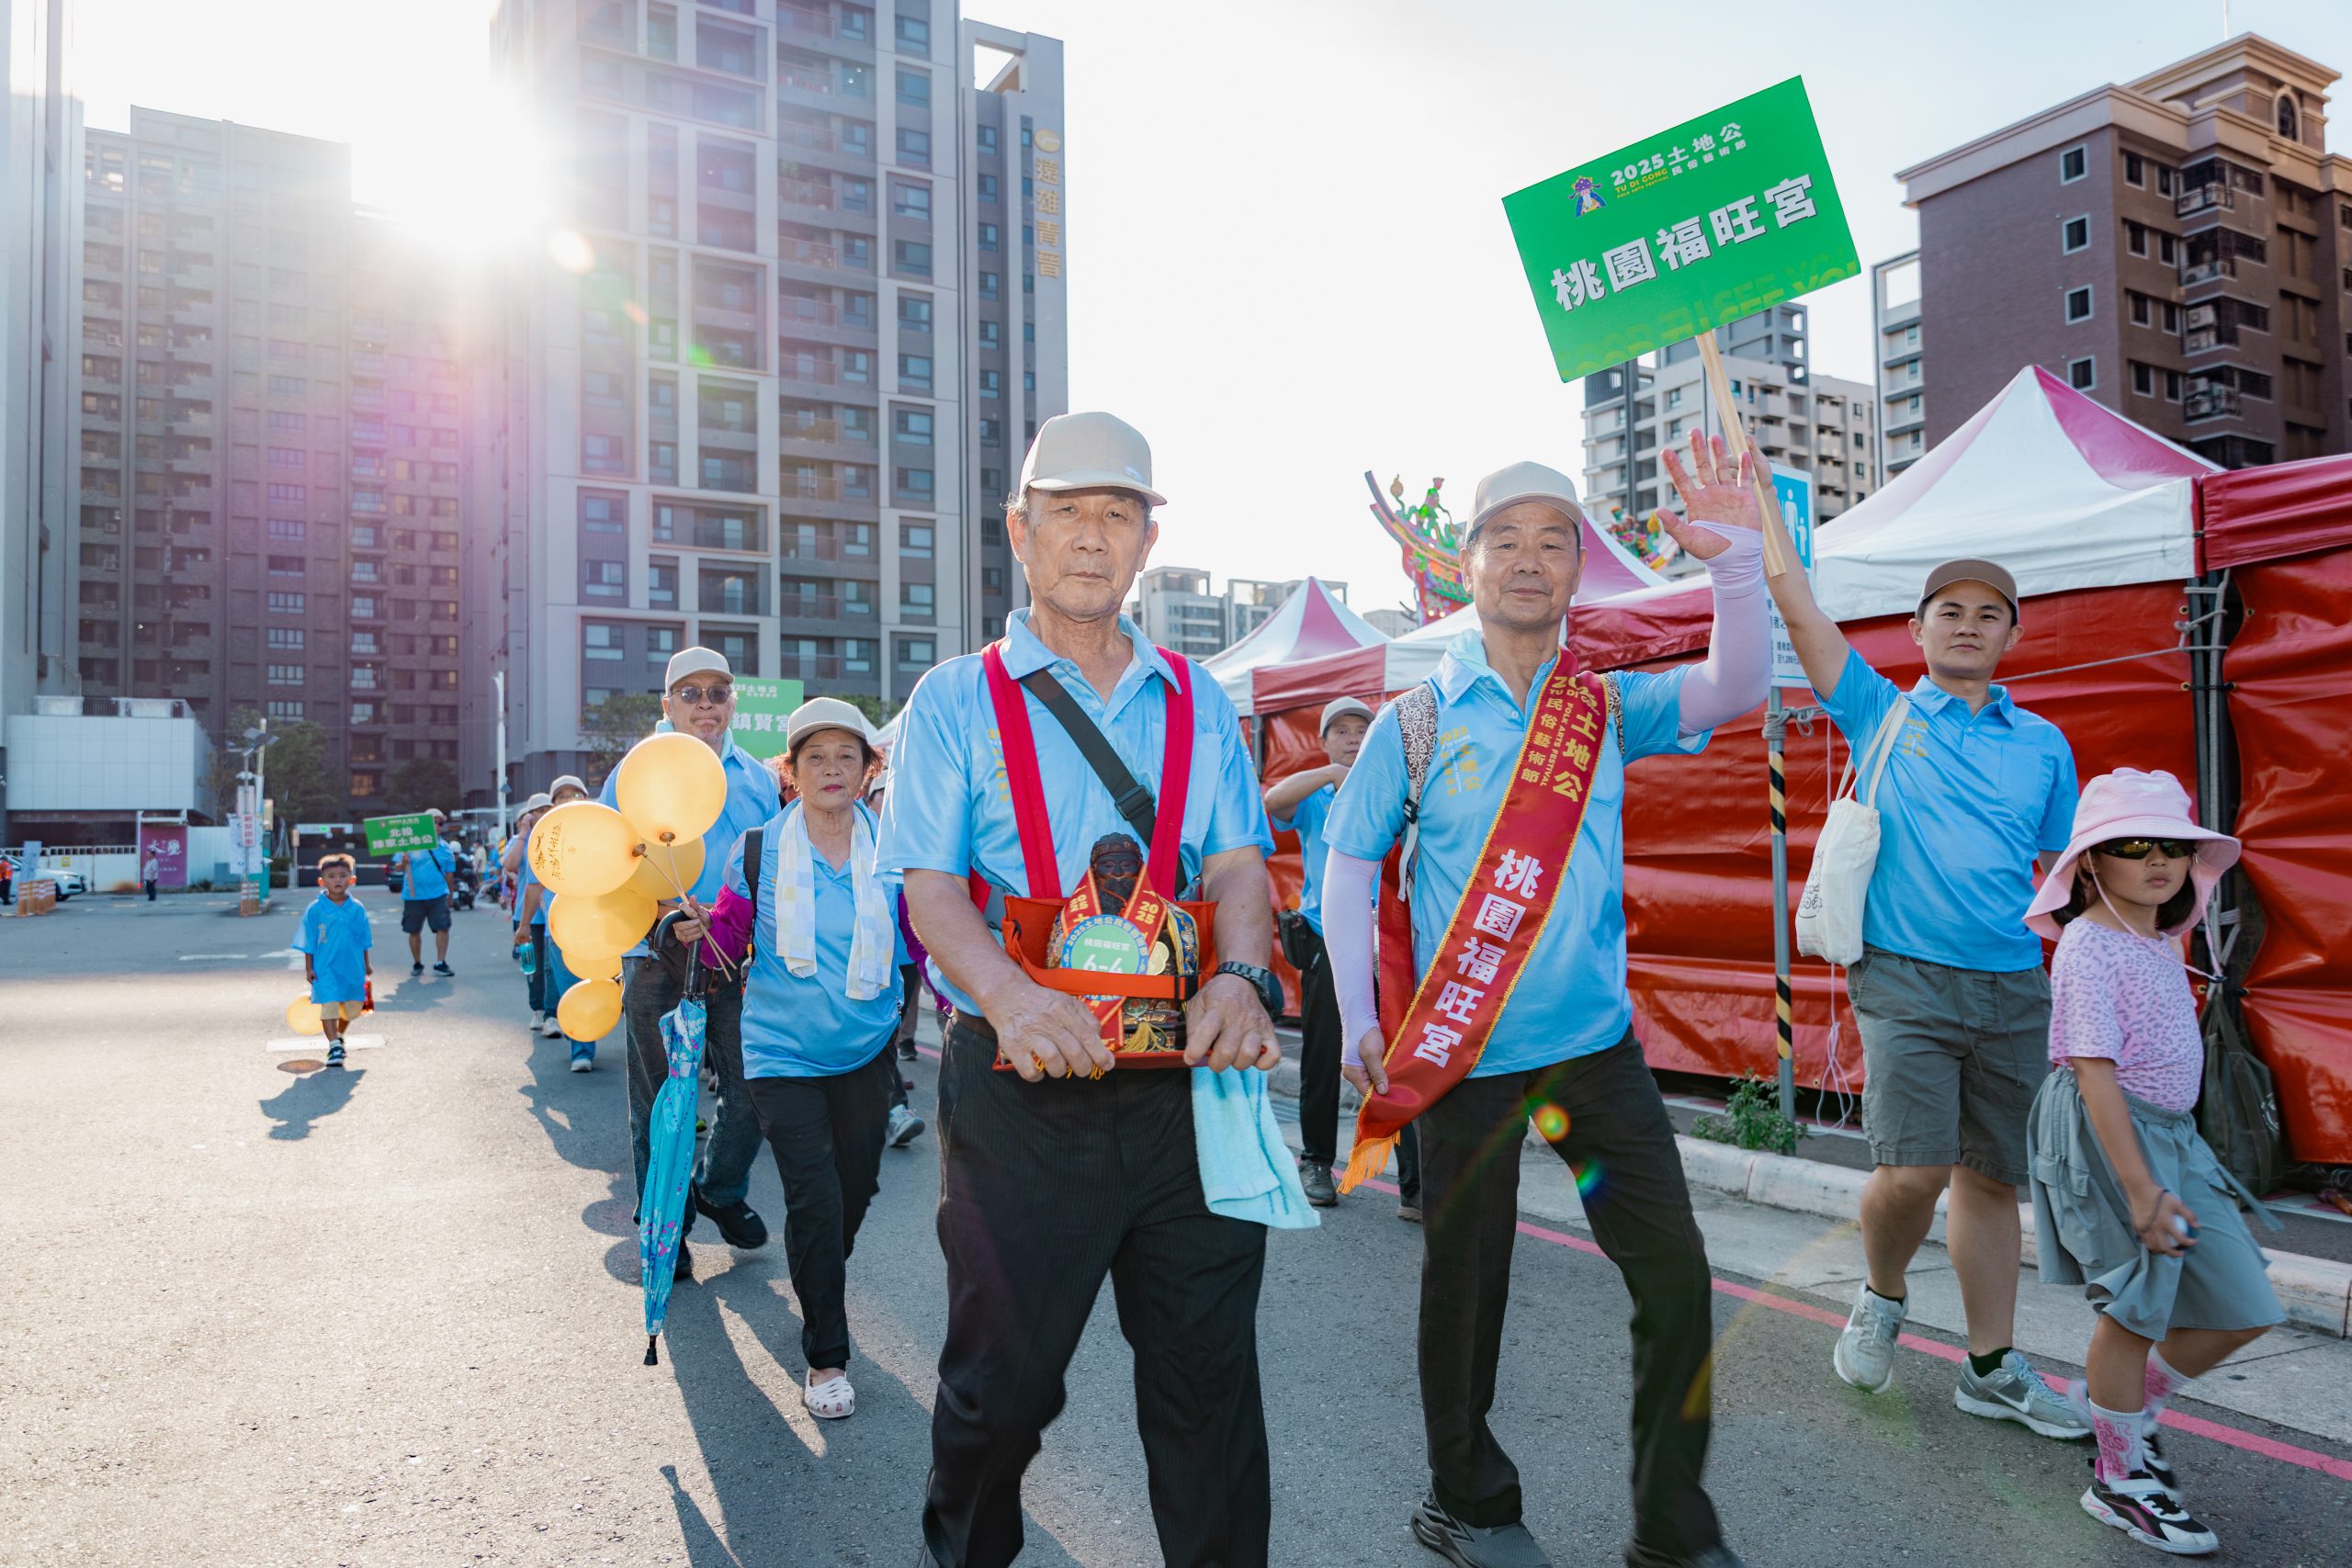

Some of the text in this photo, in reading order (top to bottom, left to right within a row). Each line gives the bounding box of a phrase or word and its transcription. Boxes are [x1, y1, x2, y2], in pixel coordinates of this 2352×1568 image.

[1615, 168, 1668, 194] TU DI GONG
[1551, 173, 1818, 312] 桃園福旺宮
[1521, 697, 1564, 784] 民俗藝術節
[1540, 703, 1574, 787] FOLK ARTS FESTIVAL
[1553, 712, 1599, 802] 土地公
[1412, 848, 1544, 1069] 桃園福旺宮
